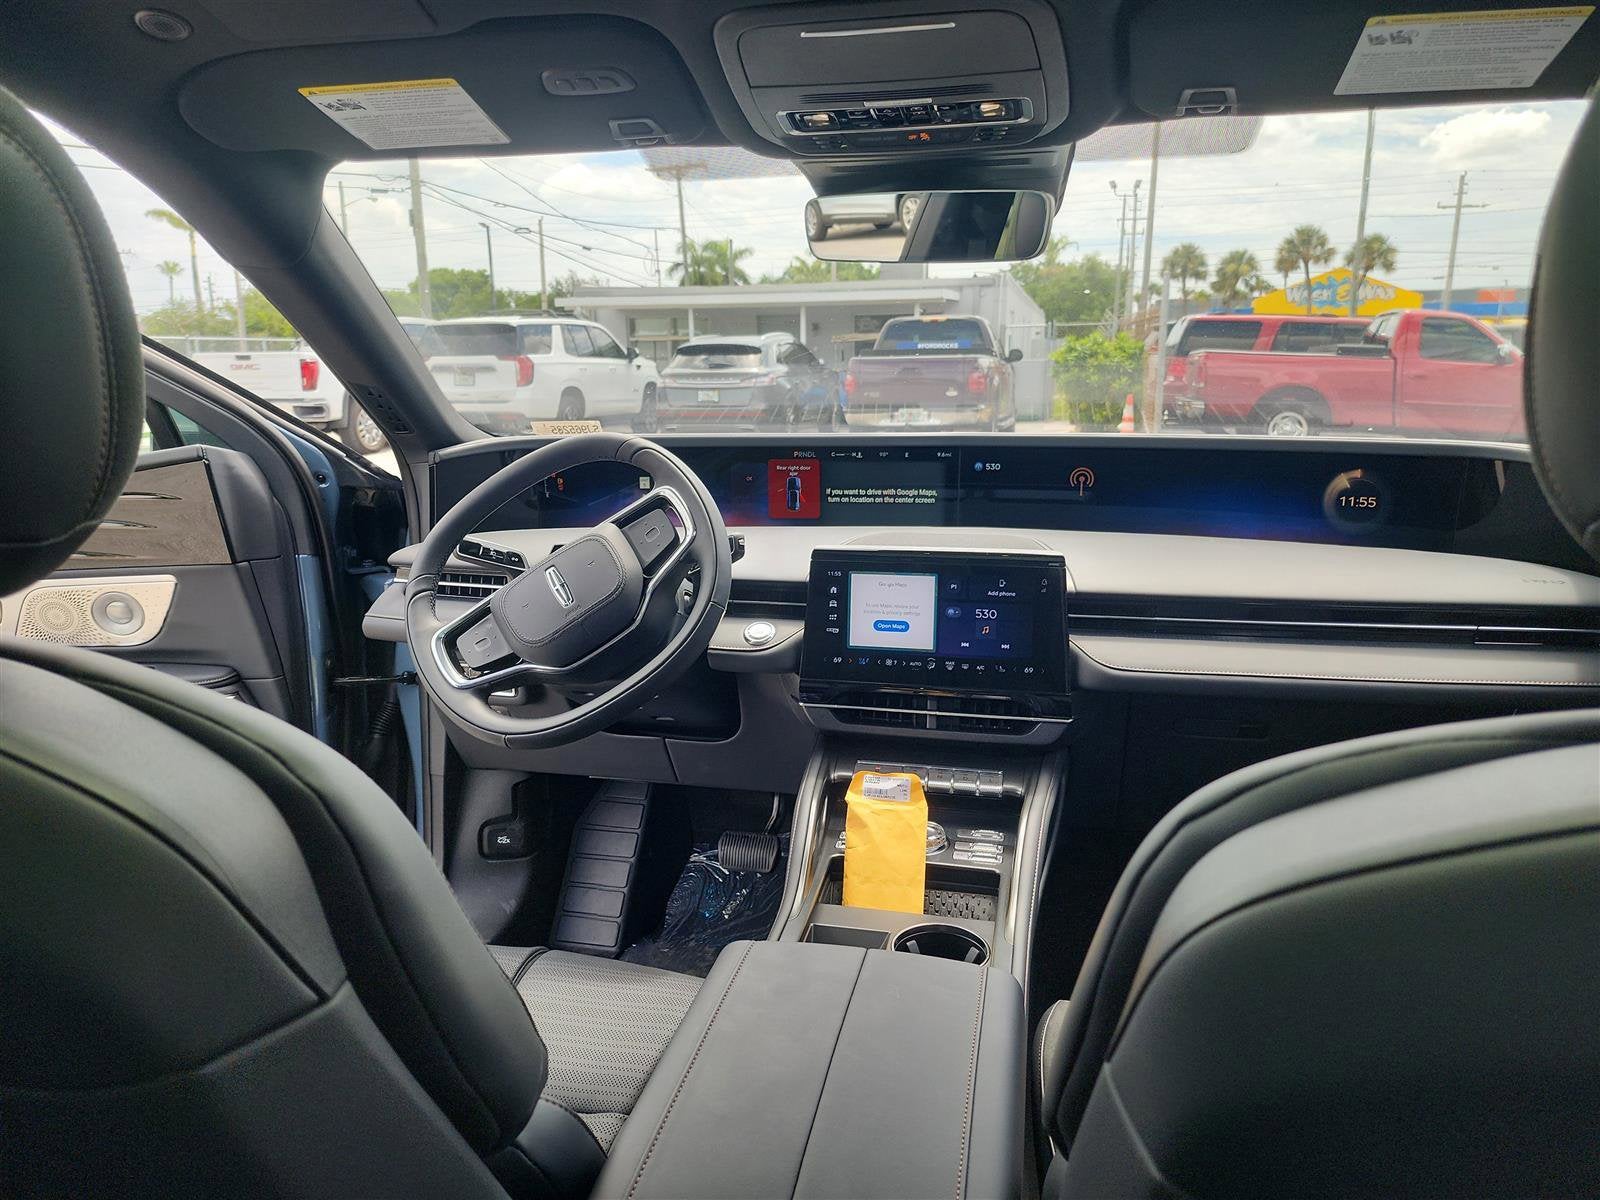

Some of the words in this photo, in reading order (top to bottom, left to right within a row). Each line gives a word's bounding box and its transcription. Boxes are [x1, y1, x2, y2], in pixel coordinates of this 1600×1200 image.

[229, 363, 261, 371] GMC
[985, 463, 1001, 471] 530
[1339, 496, 1377, 508] 11:55
[975, 608, 998, 619] 530
